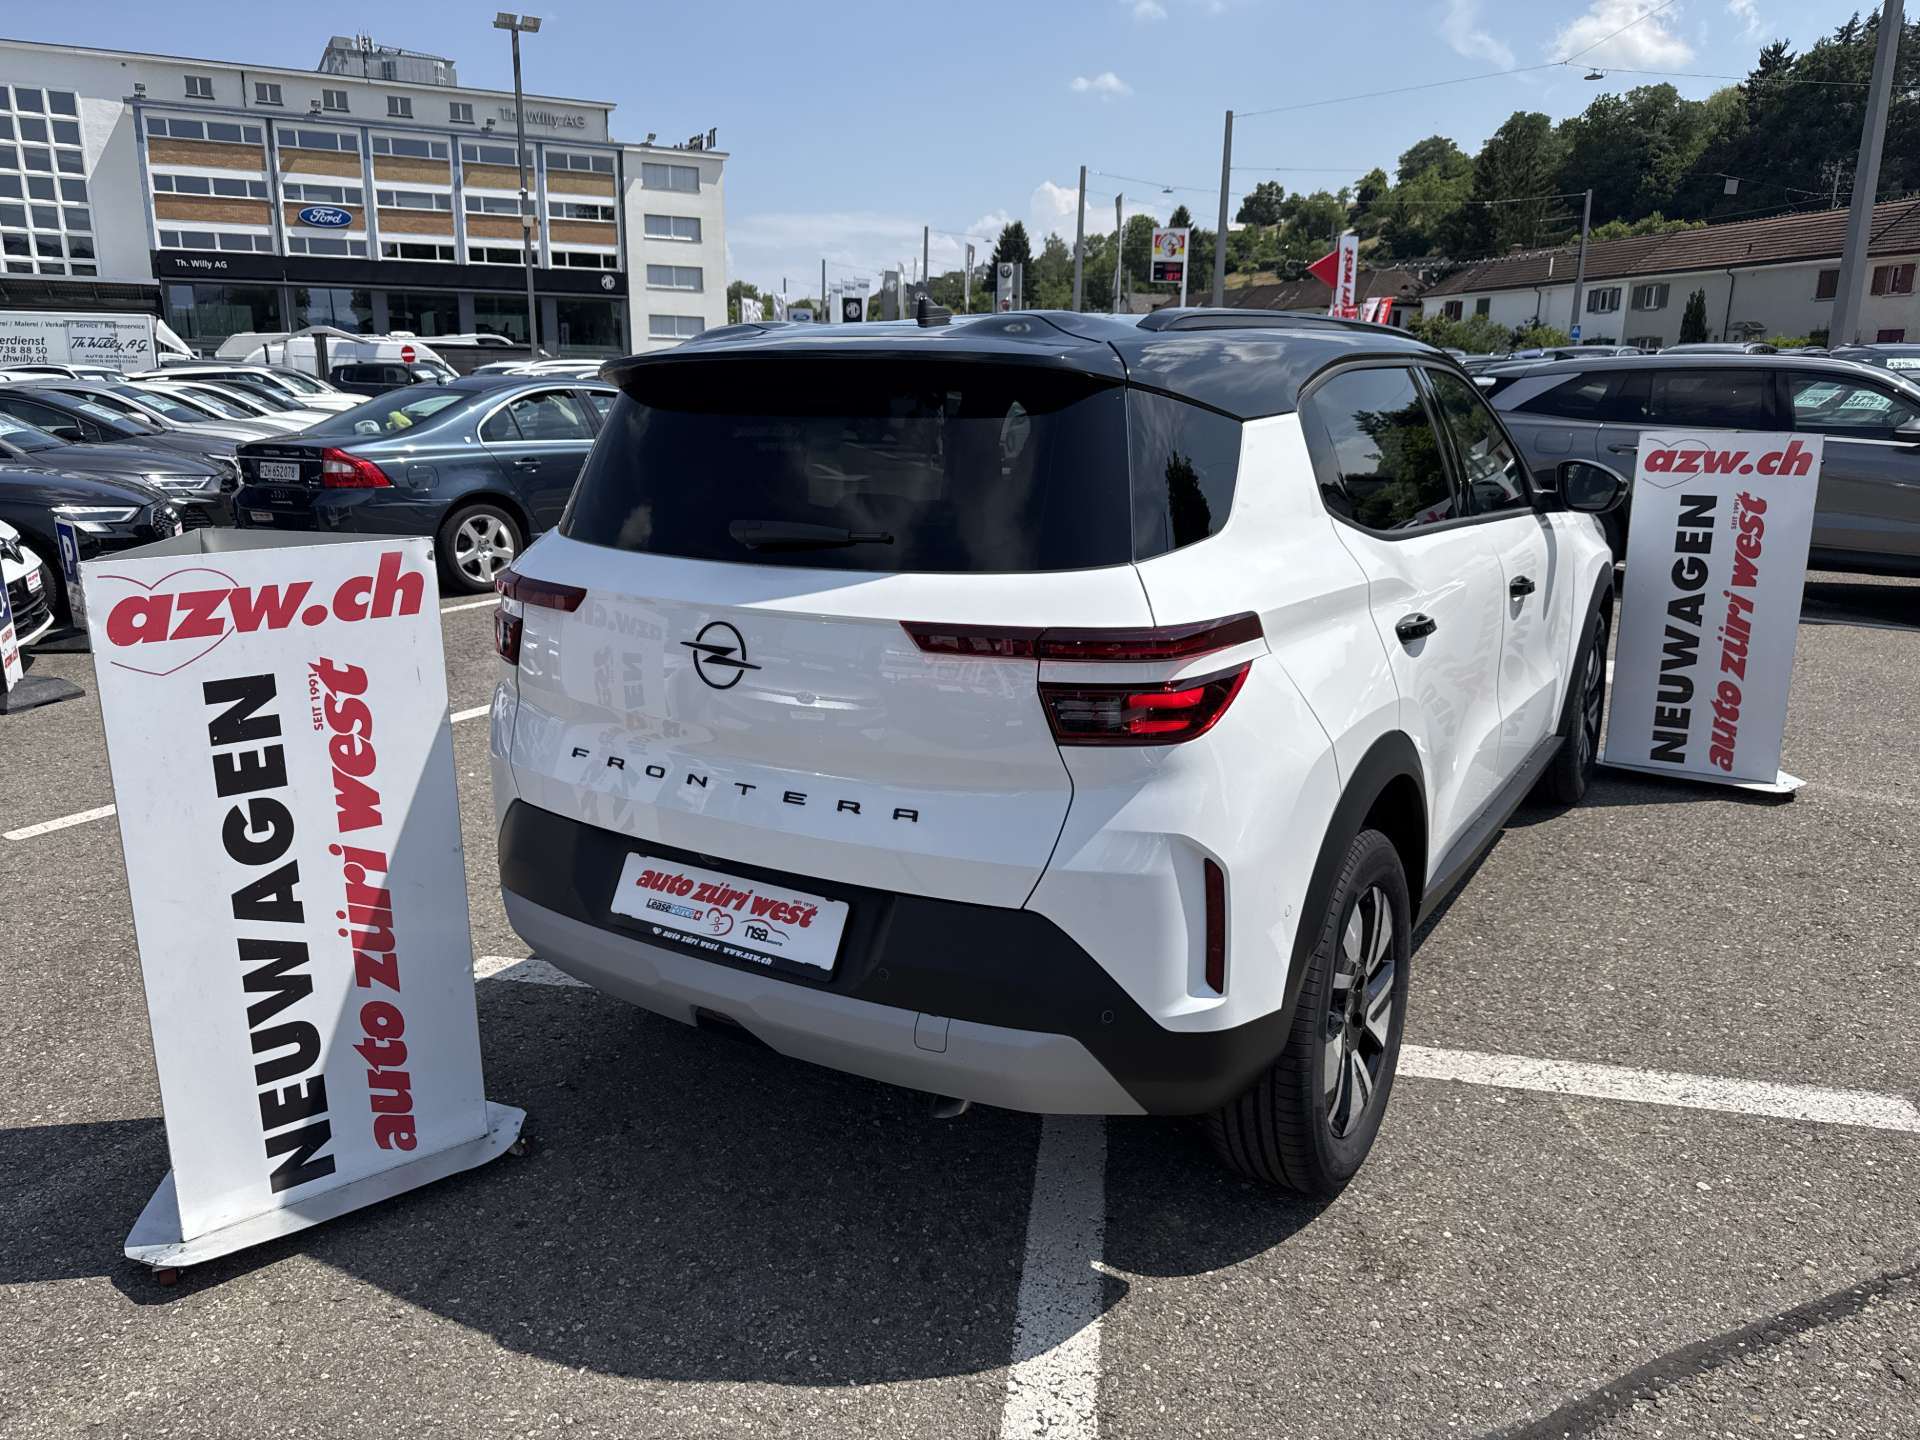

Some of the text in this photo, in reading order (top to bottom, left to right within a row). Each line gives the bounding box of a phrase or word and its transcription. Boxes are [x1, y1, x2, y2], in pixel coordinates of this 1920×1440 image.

[526, 108, 560, 129] Willy
[563, 112, 585, 129] AG
[309, 207, 343, 224] Ford
[175, 258, 228, 270] Th. Willy AG
[19, 346, 32, 354] 88
[35, 346, 48, 355] 50
[125, 338, 149, 353] AG
[1644, 440, 1814, 477] azw.ch
[1730, 514, 1738, 530] SEIT
[106, 551, 425, 647] azw.ch
[1649, 494, 1718, 764] NEUWAGEN
[1709, 491, 1768, 773] auto züri west
[308, 671, 324, 731] SEIT 1991
[571, 746, 919, 823] FRONTERA
[306, 656, 418, 1152] auto züri west
[635, 868, 819, 929] auto züri west
[202, 673, 337, 1194] NEUWAGEN
[661, 930, 681, 941] auto
[680, 933, 700, 947] züri
[700, 939, 719, 952] west
[744, 923, 770, 943] nsa
